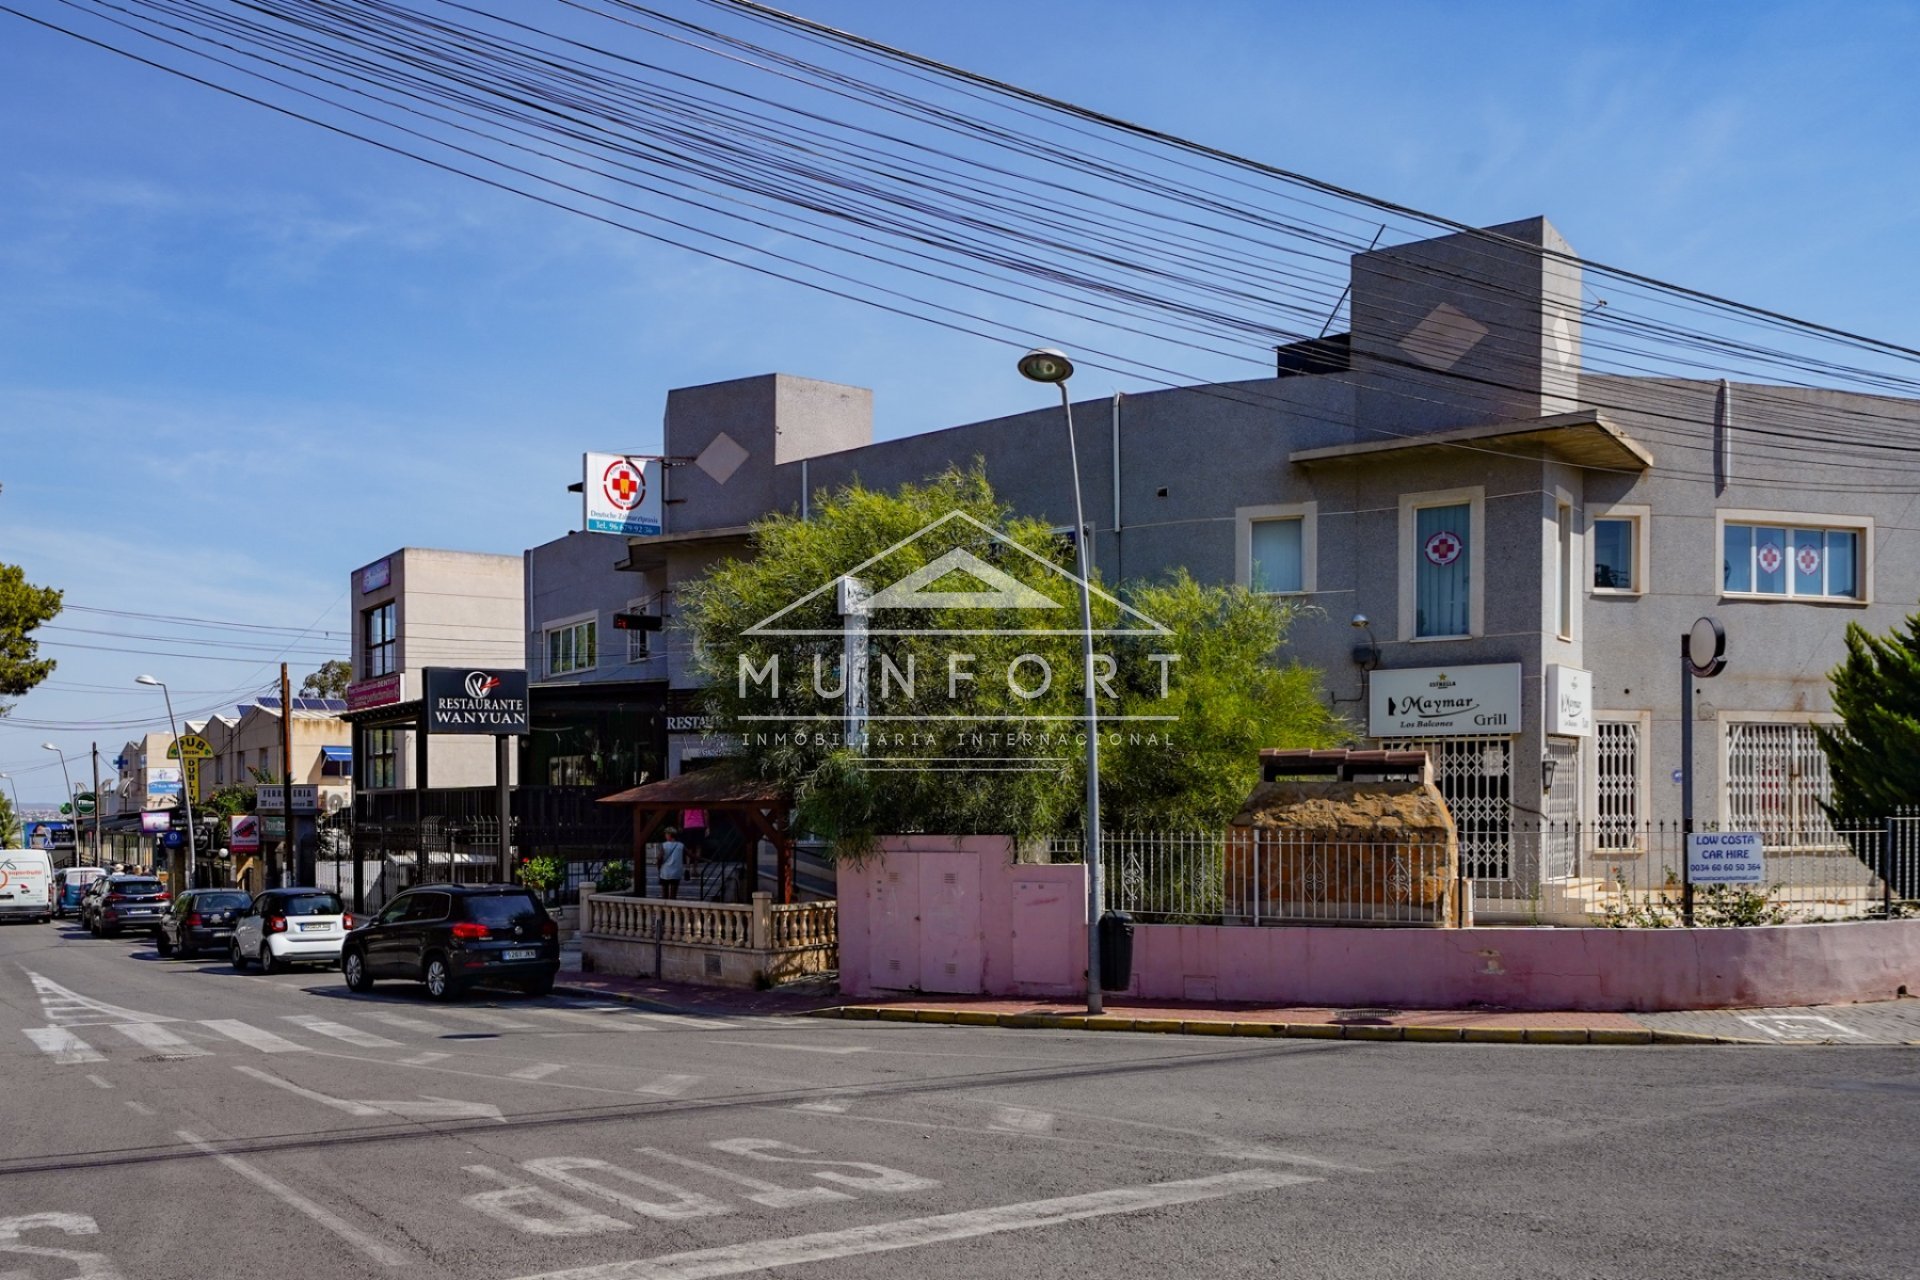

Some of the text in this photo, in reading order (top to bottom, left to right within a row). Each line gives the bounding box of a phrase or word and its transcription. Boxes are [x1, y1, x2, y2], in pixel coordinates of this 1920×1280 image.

[438, 698, 524, 711] RESTAURANTE
[1400, 695, 1473, 715] Maymar
[435, 711, 525, 724] WANYUAN
[1416, 720, 1453, 728] Balcones
[1473, 713, 1507, 726] Grill
[178, 737, 206, 750] PUB
[188, 759, 196, 803] DUBLIN
[262, 789, 312, 797] FERRERIA
[1696, 835, 1755, 845] LOW COSTA
[1702, 850, 1749, 859] CAR HIRE
[1690, 864, 1710, 872] 0034
[1712, 864, 1721, 872] 60
[460, 1137, 943, 1237] STOP
